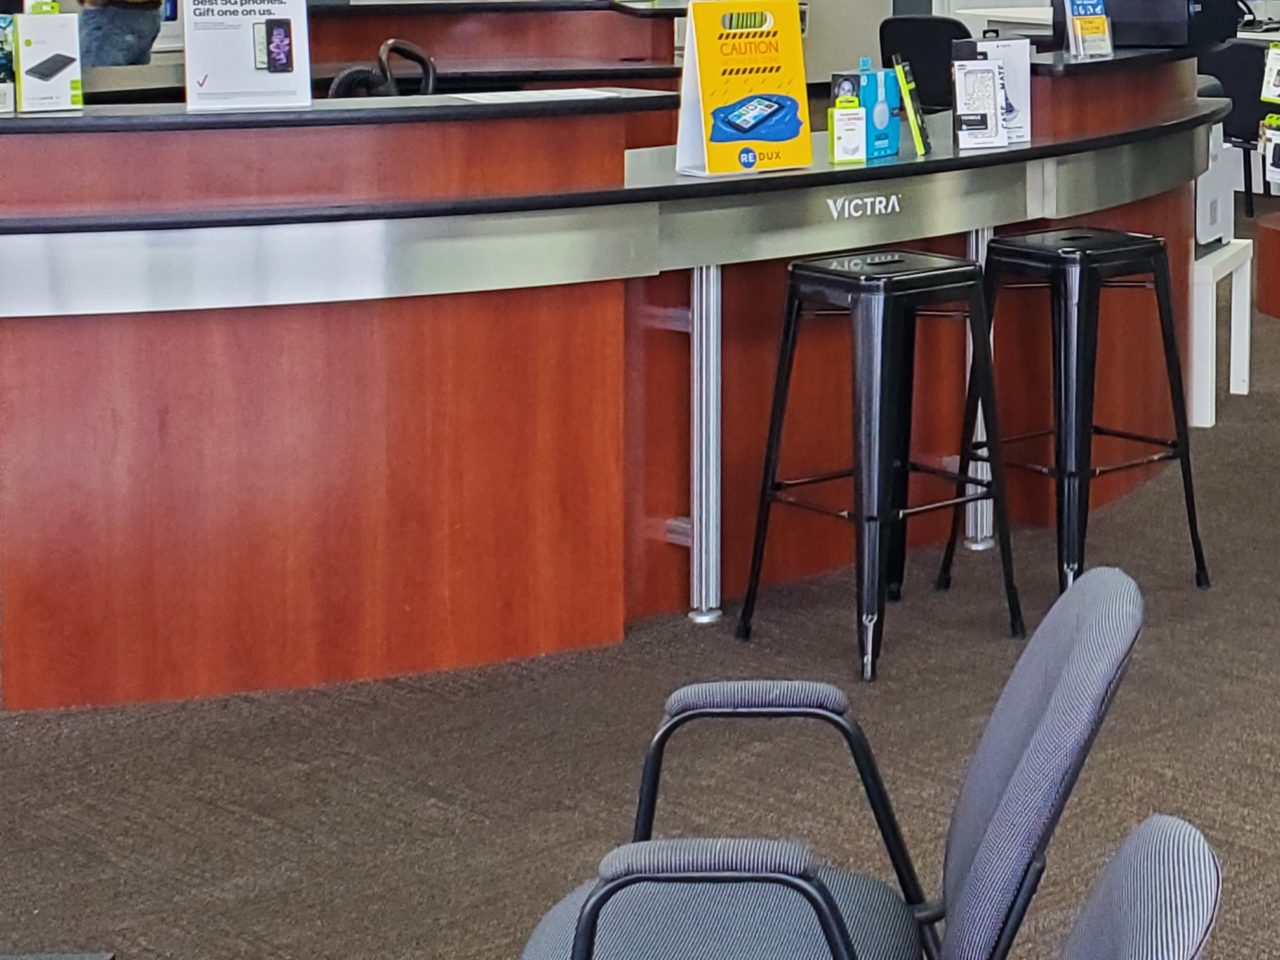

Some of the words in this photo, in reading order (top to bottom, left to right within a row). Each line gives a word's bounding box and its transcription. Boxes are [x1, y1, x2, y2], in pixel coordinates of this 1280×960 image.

[193, 7, 215, 17] Gift
[720, 40, 779, 56] CAUTION
[826, 195, 901, 221] VICTRA
